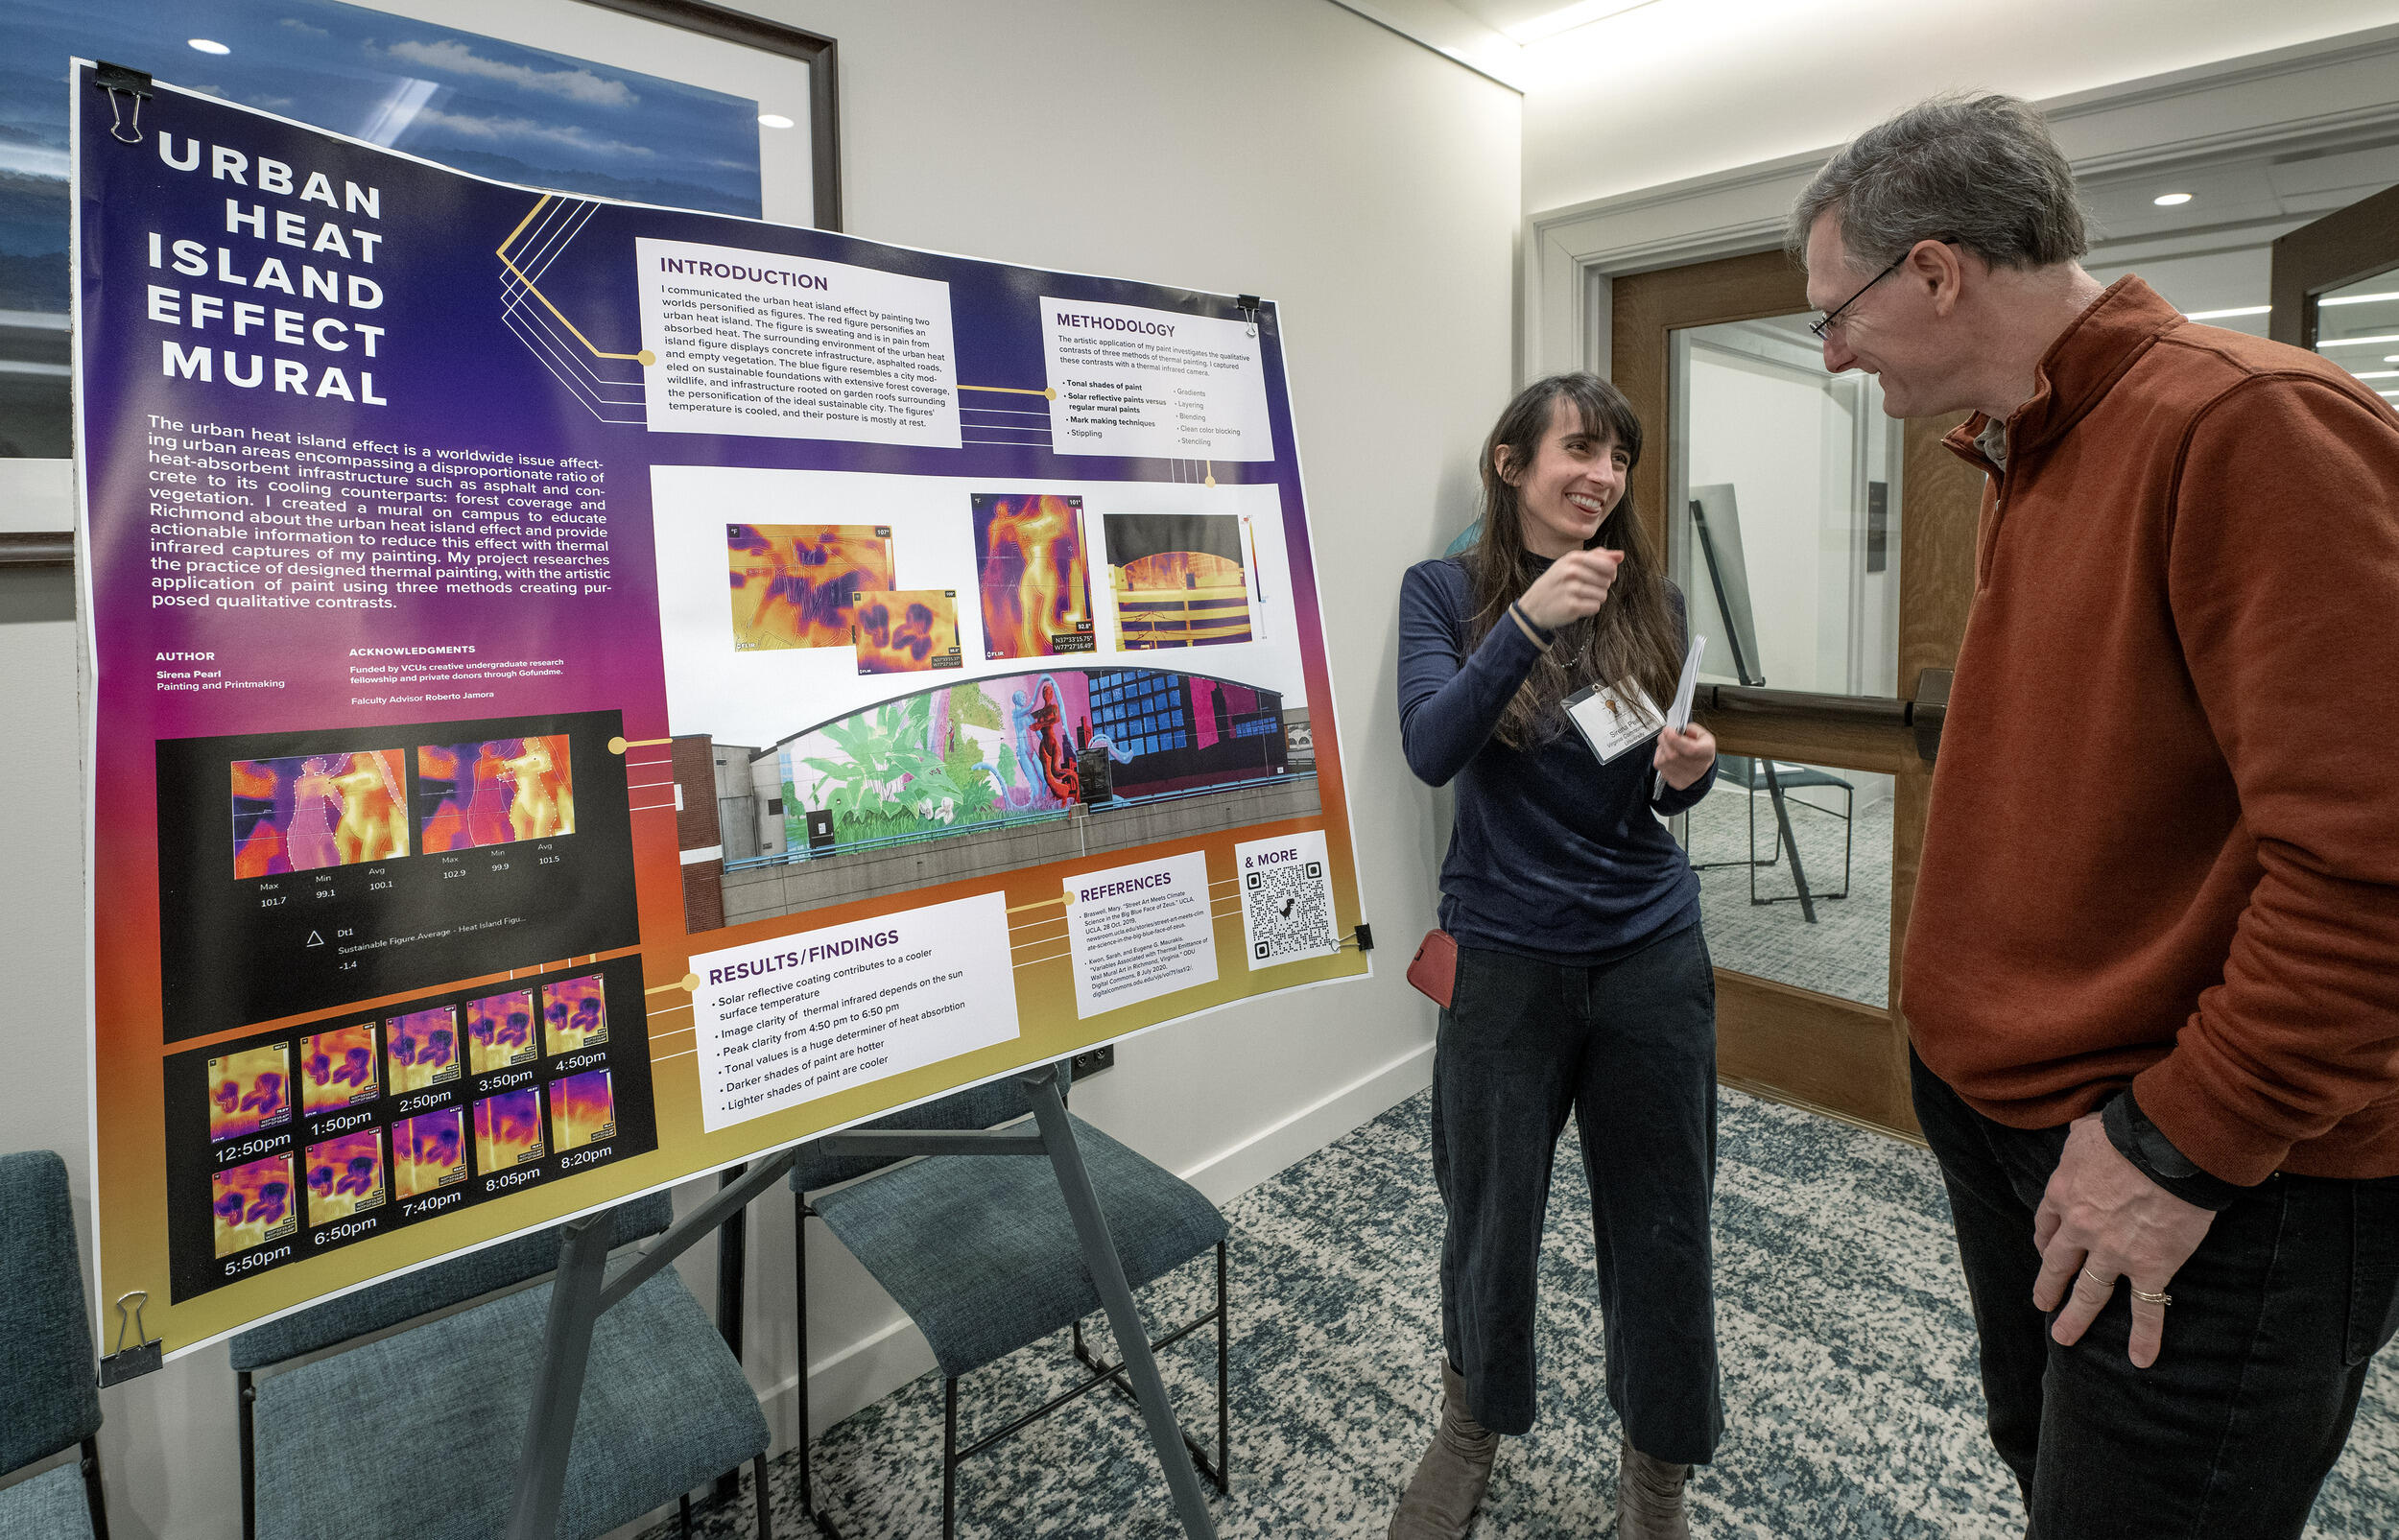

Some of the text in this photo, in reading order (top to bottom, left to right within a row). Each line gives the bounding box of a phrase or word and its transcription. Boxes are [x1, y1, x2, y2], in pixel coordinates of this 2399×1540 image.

[159, 130, 379, 219] URBAN
[227, 199, 382, 263] HEAT
[150, 232, 383, 309] ISLAND
[661, 257, 827, 291] INTRODUCTION
[668, 287, 741, 300] communicated
[745, 294, 760, 302] the
[793, 299, 813, 308] heat
[816, 301, 841, 312] island
[843, 306, 867, 316] effect
[869, 310, 879, 320] by
[881, 313, 913, 324] painting
[148, 285, 385, 357] EFFECT
[1057, 313, 1175, 337] METHODOLOGY
[162, 341, 387, 407] MURAL
[1176, 388, 1205, 396] Gradients
[1177, 400, 1203, 410] Layering
[1090, 417, 1117, 426] making
[1179, 413, 1205, 422] Blending
[148, 415, 603, 468] The urban heat island effect is a worldwide issue affect-
[1071, 429, 1102, 438] Stippling
[149, 436, 604, 483] ing urban areas encompassing a disproportionate ratio of
[153, 594, 396, 609] posed qualitative contrasts.
[349, 646, 475, 656] ACKNOWLEDGMENTS
[157, 682, 199, 691] Painting
[225, 679, 284, 688] Printmaking
[419, 674, 449, 682] private
[1246, 848, 1297, 868] & MORE
[317, 889, 335, 898] 99.1
[370, 881, 392, 889] 100.1
[1081, 872, 1171, 902] REFERENCES
[262, 896, 286, 907] 101.7
[338, 941, 388, 955] Sustainable
[459, 923, 479, 934] Heat
[480, 919, 501, 930] Island
[340, 960, 356, 969] -1.4
[710, 930, 898, 985] RESULTS/FINDINGS
[719, 994, 745, 1006] Solar
[748, 983, 793, 999] reflective
[796, 974, 830, 987] coating
[833, 960, 884, 978] contributes
[906, 950, 932, 960] cooler
[720, 990, 819, 1020] surface temperature
[724, 1043, 748, 1055] Peak
[752, 1034, 781, 1048] clarity
[784, 1028, 806, 1039] from
[809, 1020, 830, 1031] 4:50
[833, 1017, 847, 1028] pm
[862, 1006, 882, 1018] 6:50
[886, 1004, 899, 1014] pm
[556, 1051, 606, 1072] 4:50pm
[726, 1041, 884, 1092] Darker shades of paint are hotter
[479, 1070, 534, 1092] 3:50pm
[399, 1090, 452, 1113] 2:50pm
[311, 1111, 371, 1136] 1:50pm
[215, 1134, 291, 1163] 12:50pm
[561, 1147, 612, 1170] 8:20pm
[486, 1167, 541, 1193] 8:05pm
[403, 1192, 462, 1218] 7:40pm
[315, 1217, 376, 1245] 6:50pm
[225, 1245, 291, 1276] 5:50pm
